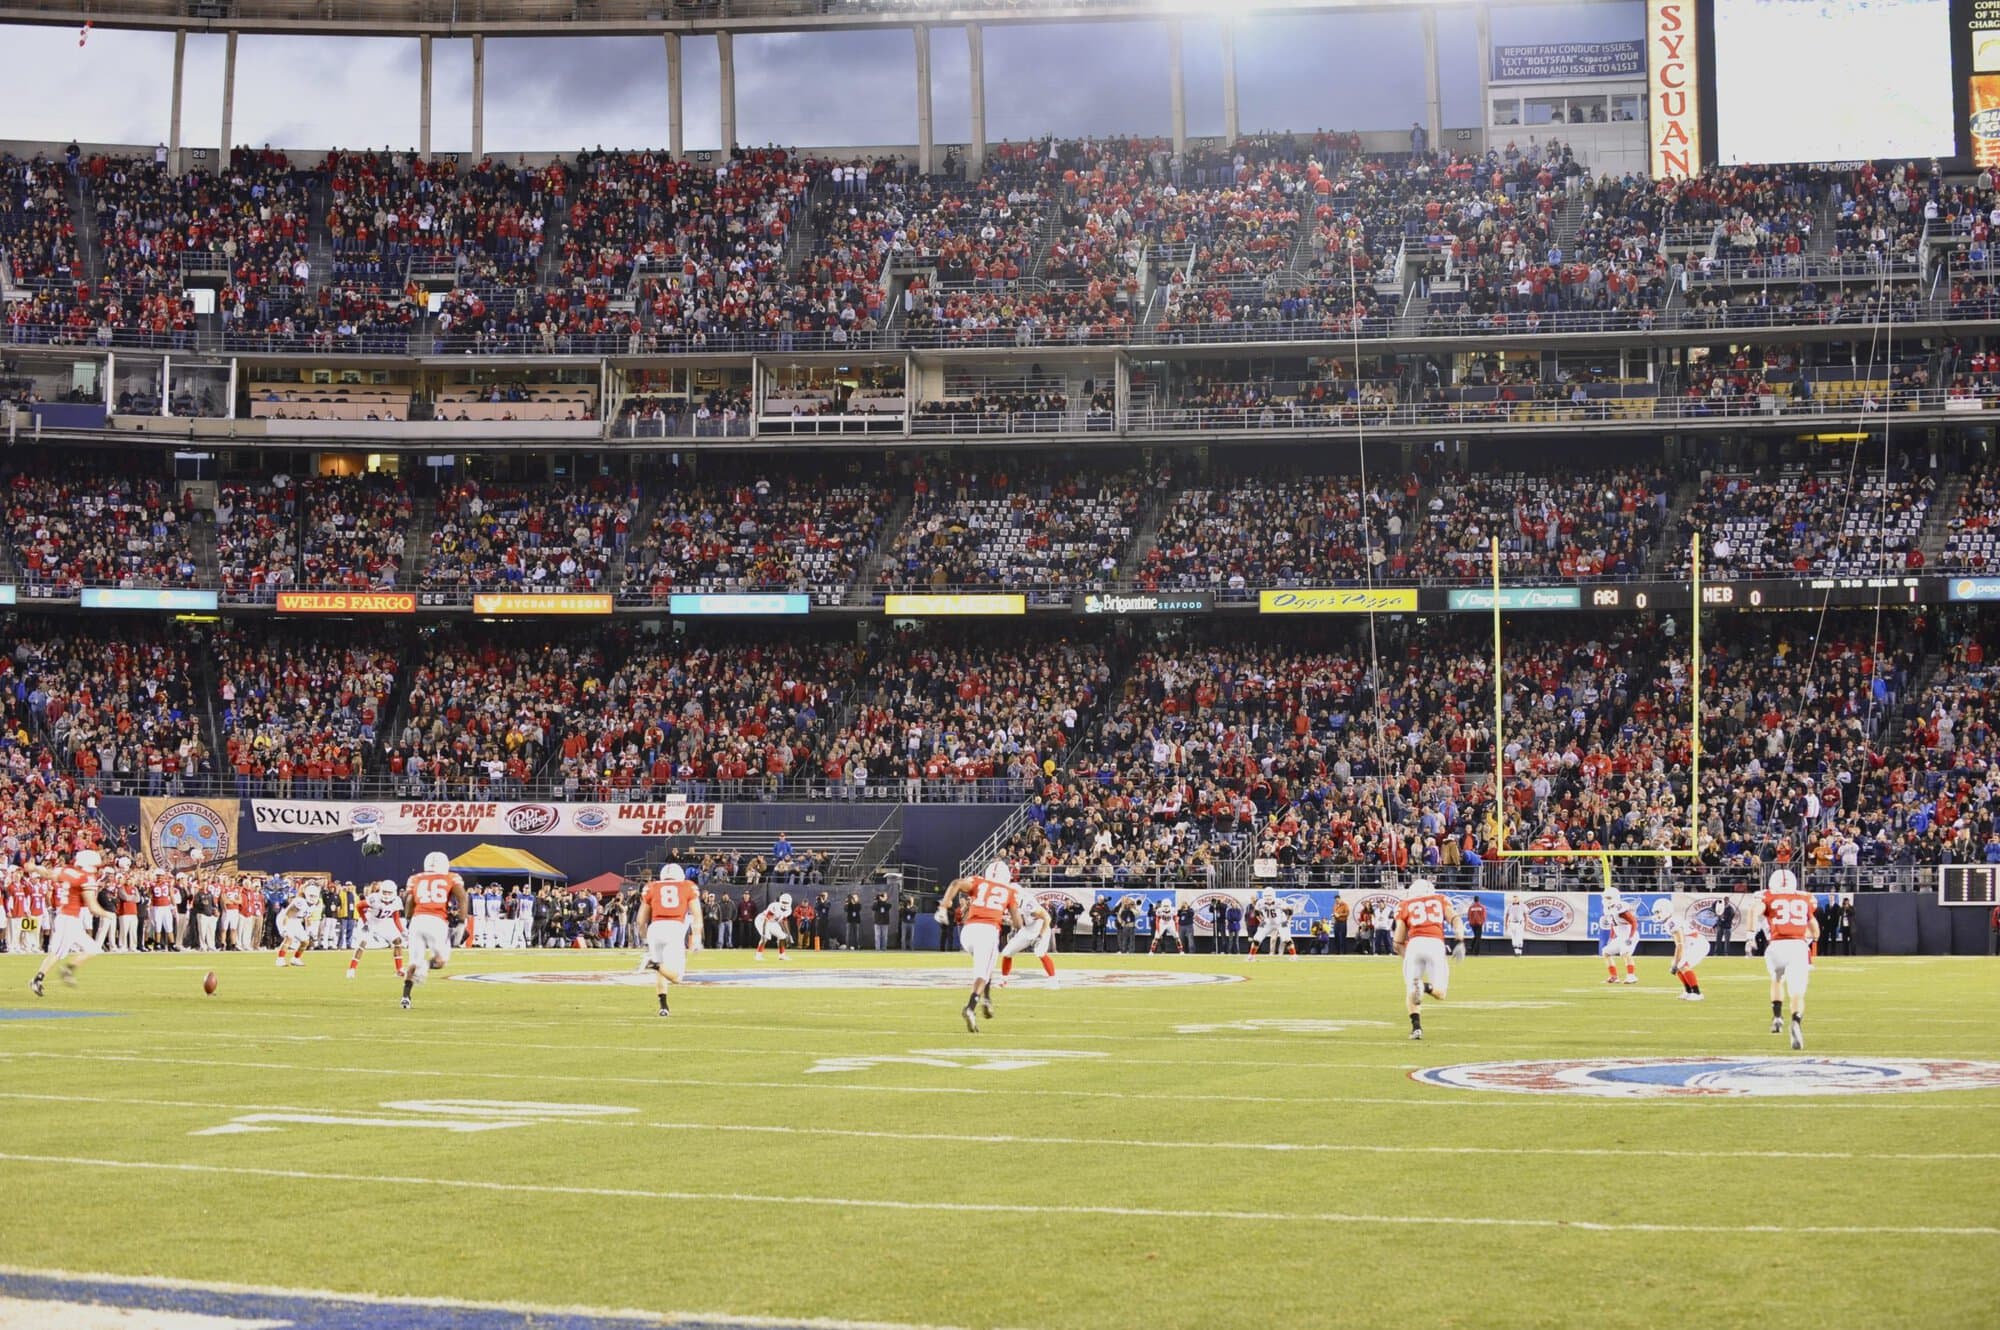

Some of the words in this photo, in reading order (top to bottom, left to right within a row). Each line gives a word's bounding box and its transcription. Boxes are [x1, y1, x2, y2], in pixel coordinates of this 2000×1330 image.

[1975, 11, 1988, 19] OF
[1504, 47, 1538, 56] REPORT
[1539, 46, 1557, 54] FAN
[1559, 45, 1601, 53] CONDUCT
[1501, 57, 1522, 66] TEXT
[1614, 52, 1639, 62] YOUR
[1503, 66, 1548, 76] LOCATION
[1549, 65, 1568, 74] AND
[1570, 64, 1597, 73] ISSUE
[1599, 63, 1609, 72] TO
[1611, 61, 1638, 71] 41513
[1658, 5, 1689, 175] SYCUAN
[193, 150, 206, 159] 28
[697, 152, 710, 160] 26
[1977, 585, 2000, 594] pep
[281, 596, 346, 610] WELLS
[350, 596, 412, 610] FARGO
[1104, 594, 1157, 613] Brigantine
[1593, 590, 1619, 605] ARI
[1636, 592, 1647, 608] 0
[1750, 590, 1761, 606] 0
[159, 804, 194, 825] SYCUAN
[195, 806, 220, 826] BAND
[256, 806, 340, 825] SYCUAN
[400, 804, 497, 818] PREGAME
[525, 808, 541, 820] Dr
[416, 818, 480, 833] SHOW
[510, 811, 551, 831] Pepper
[641, 820, 705, 835] SHOW
[154, 885, 169, 897] 93
[417, 879, 447, 904] 46
[660, 885, 680, 908] 8
[972, 883, 1009, 911] 12
[1526, 898, 1551, 909] PACIFIC
[1551, 899, 1567, 911] LIFE
[1770, 899, 1809, 925] 39
[1264, 908, 1278, 919] 76
[1407, 899, 1443, 927] 33
[1526, 921, 1551, 933] OLIDAY
[1551, 920, 1568, 933] BOWL
